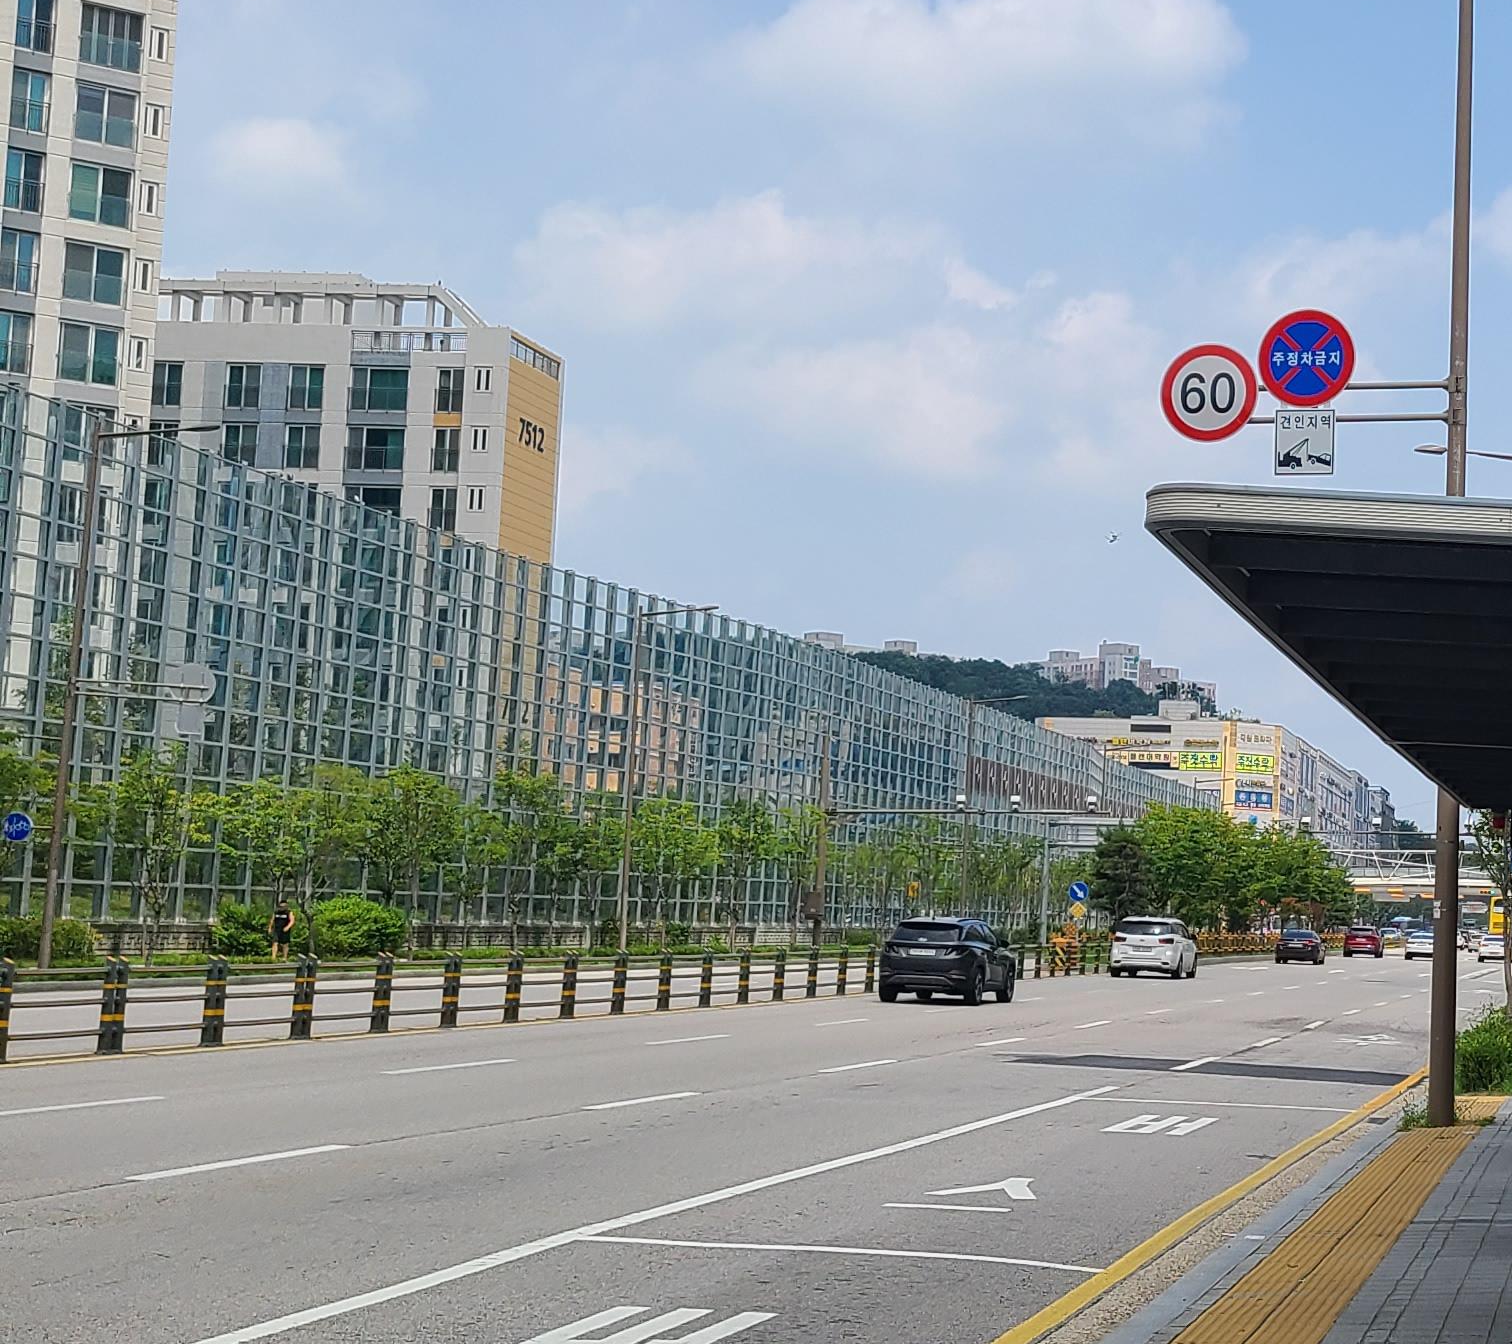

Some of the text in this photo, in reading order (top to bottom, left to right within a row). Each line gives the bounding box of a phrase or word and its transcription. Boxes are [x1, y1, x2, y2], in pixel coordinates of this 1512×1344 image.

[1271, 350, 1341, 367] 주정차금지
[1180, 372, 1236, 414] 60
[518, 416, 545, 454] 7512
[1280, 414, 1332, 430] 견인지역
